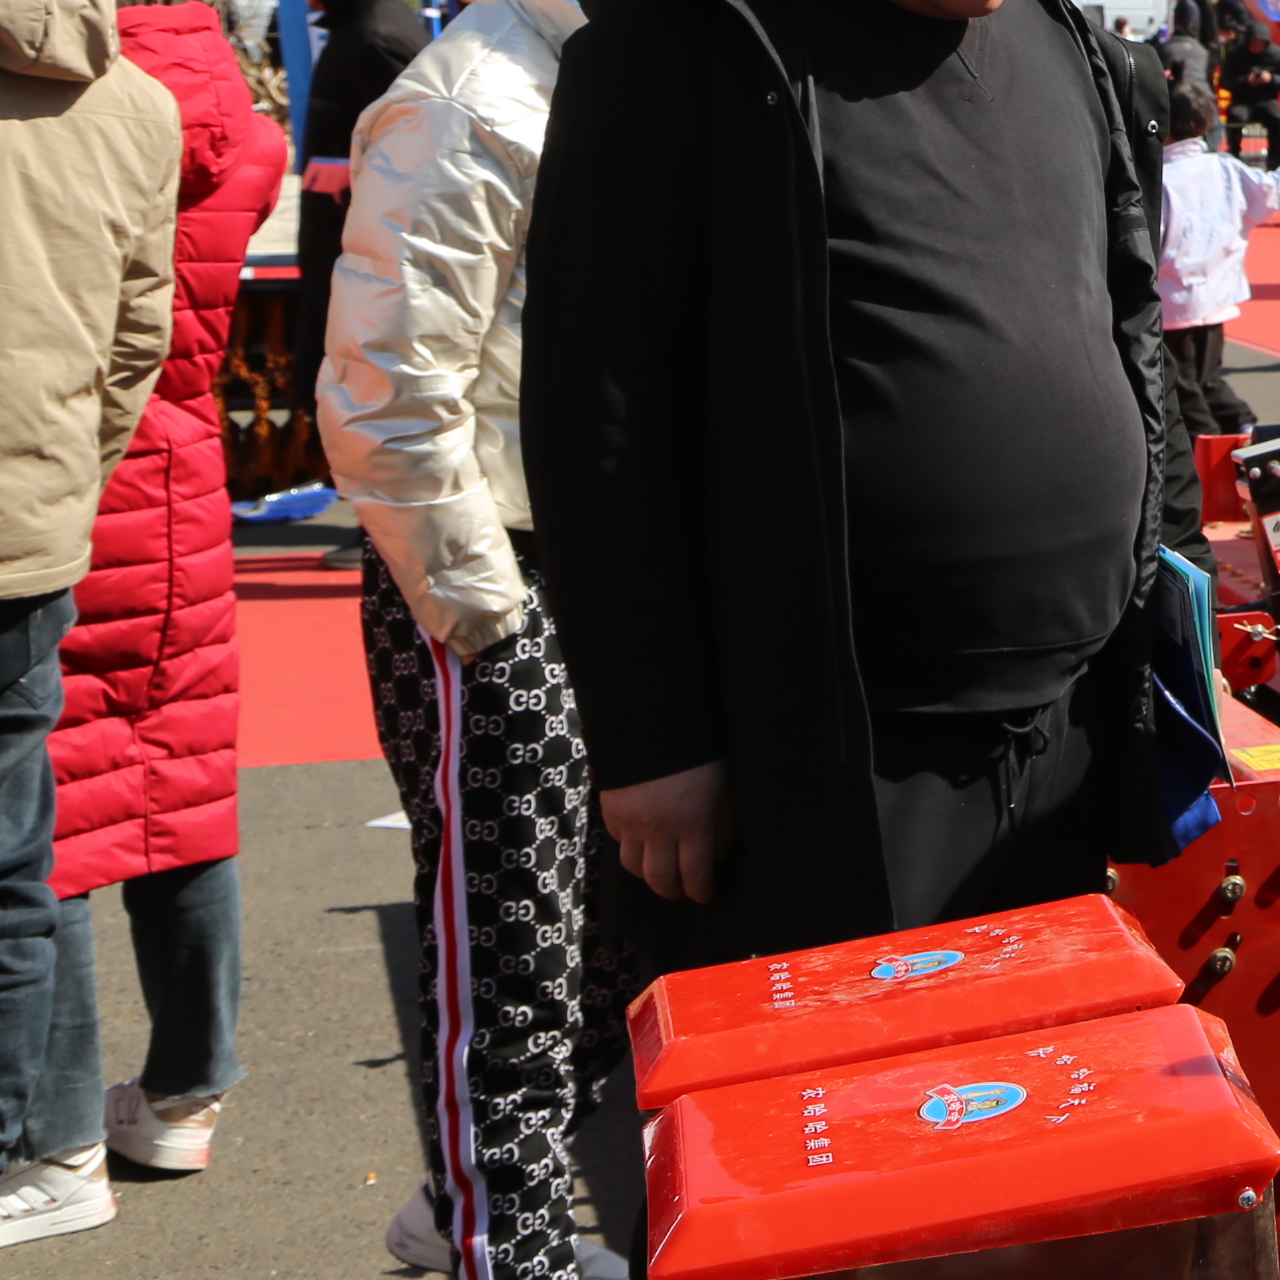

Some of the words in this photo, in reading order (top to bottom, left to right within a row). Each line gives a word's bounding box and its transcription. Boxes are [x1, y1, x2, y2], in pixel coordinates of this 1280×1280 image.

[801, 1086, 834, 1167] 农哈哈集团
[941, 1092, 965, 1123] 农哈哈
